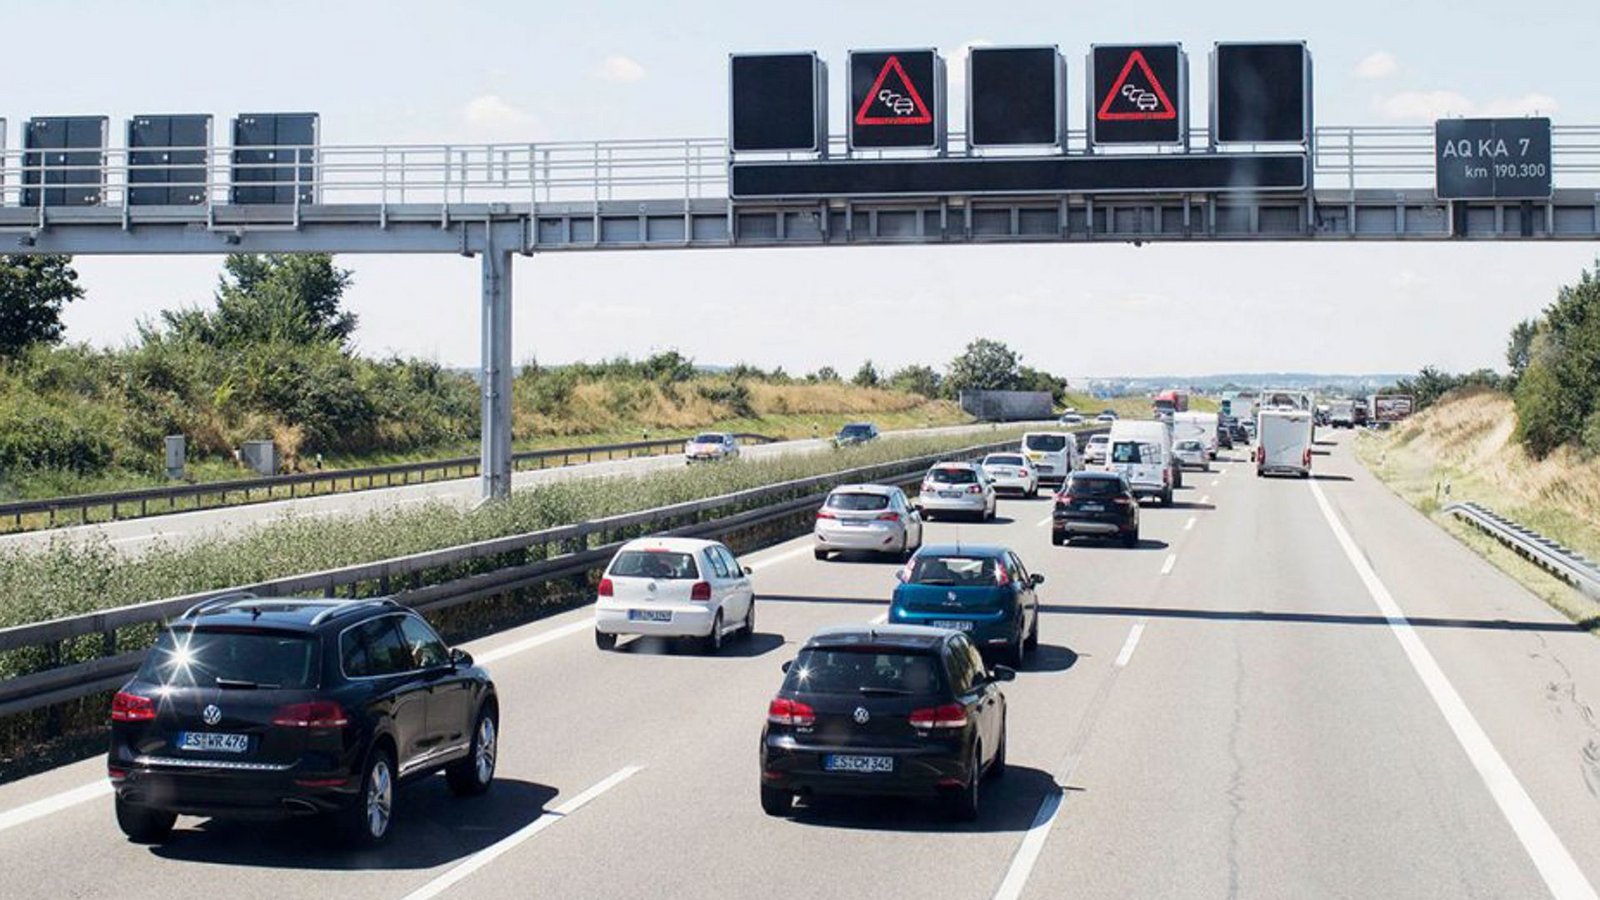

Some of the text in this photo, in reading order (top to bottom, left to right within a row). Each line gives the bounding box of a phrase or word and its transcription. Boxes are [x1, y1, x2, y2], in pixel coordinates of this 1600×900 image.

[1443, 138, 1530, 158] AQ KA 7
[1464, 165, 1488, 178] km
